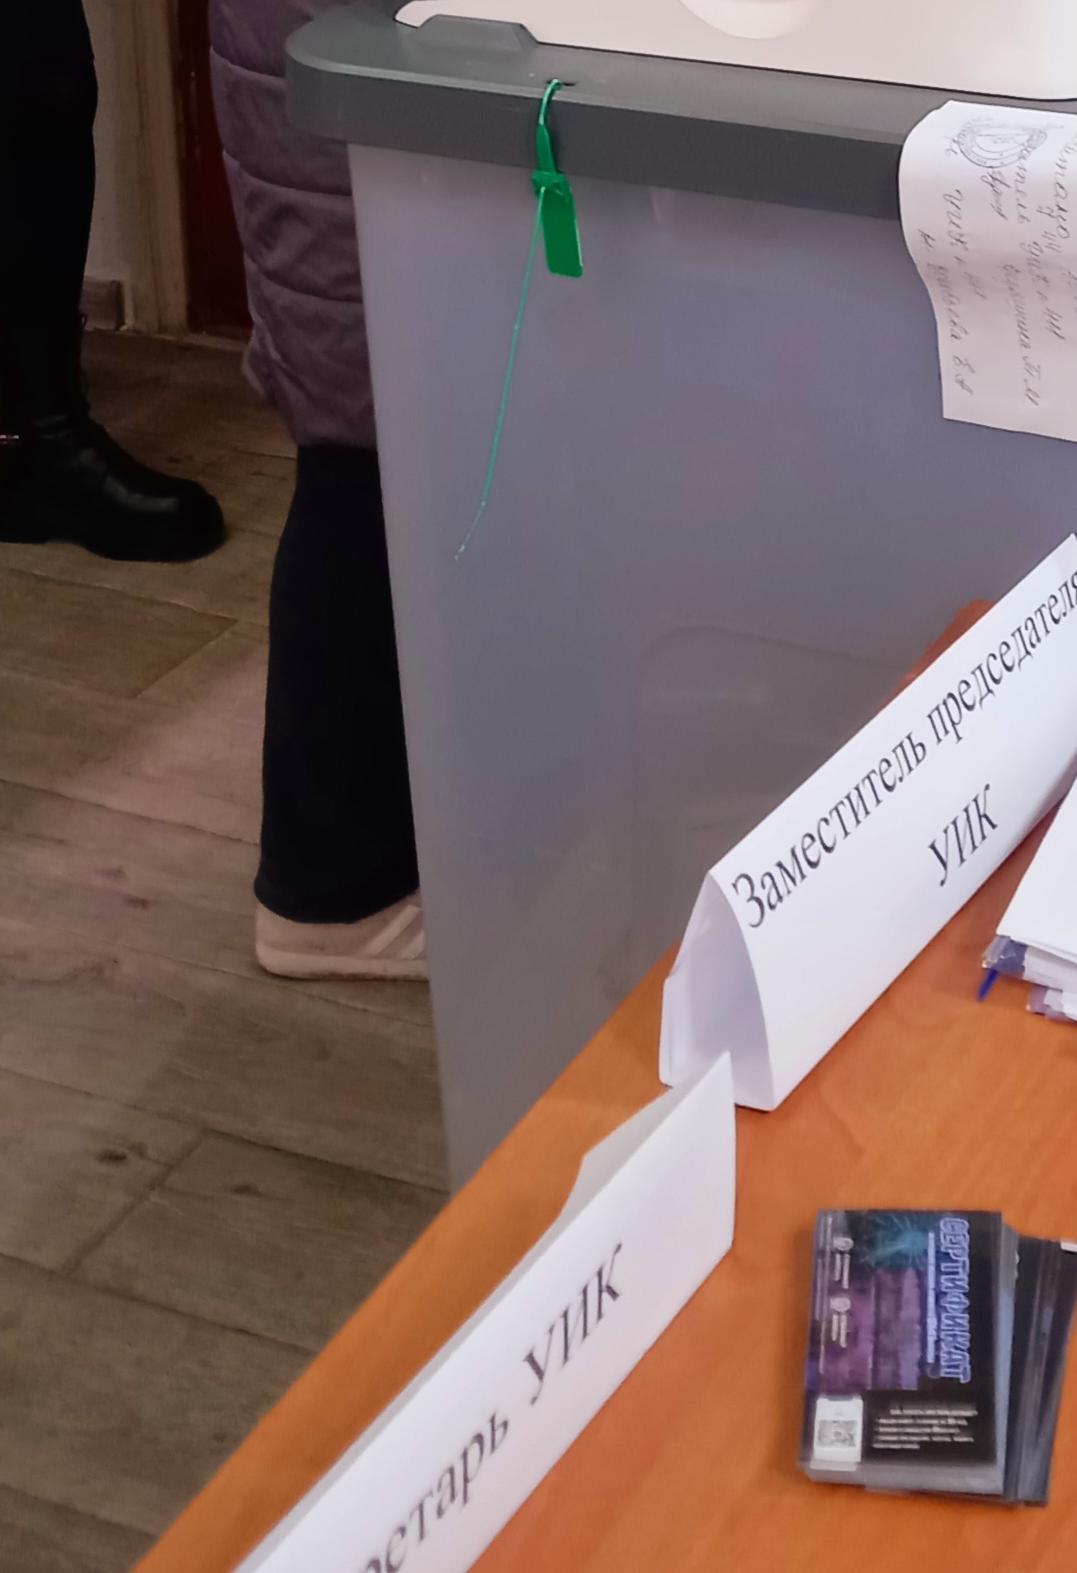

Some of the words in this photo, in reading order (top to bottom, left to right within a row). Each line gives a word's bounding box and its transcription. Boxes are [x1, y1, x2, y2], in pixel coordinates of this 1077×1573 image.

[731, 731, 928, 928] Заместитель
[927, 783, 999, 887] УИК
[523, 1242, 623, 1405] УИК
